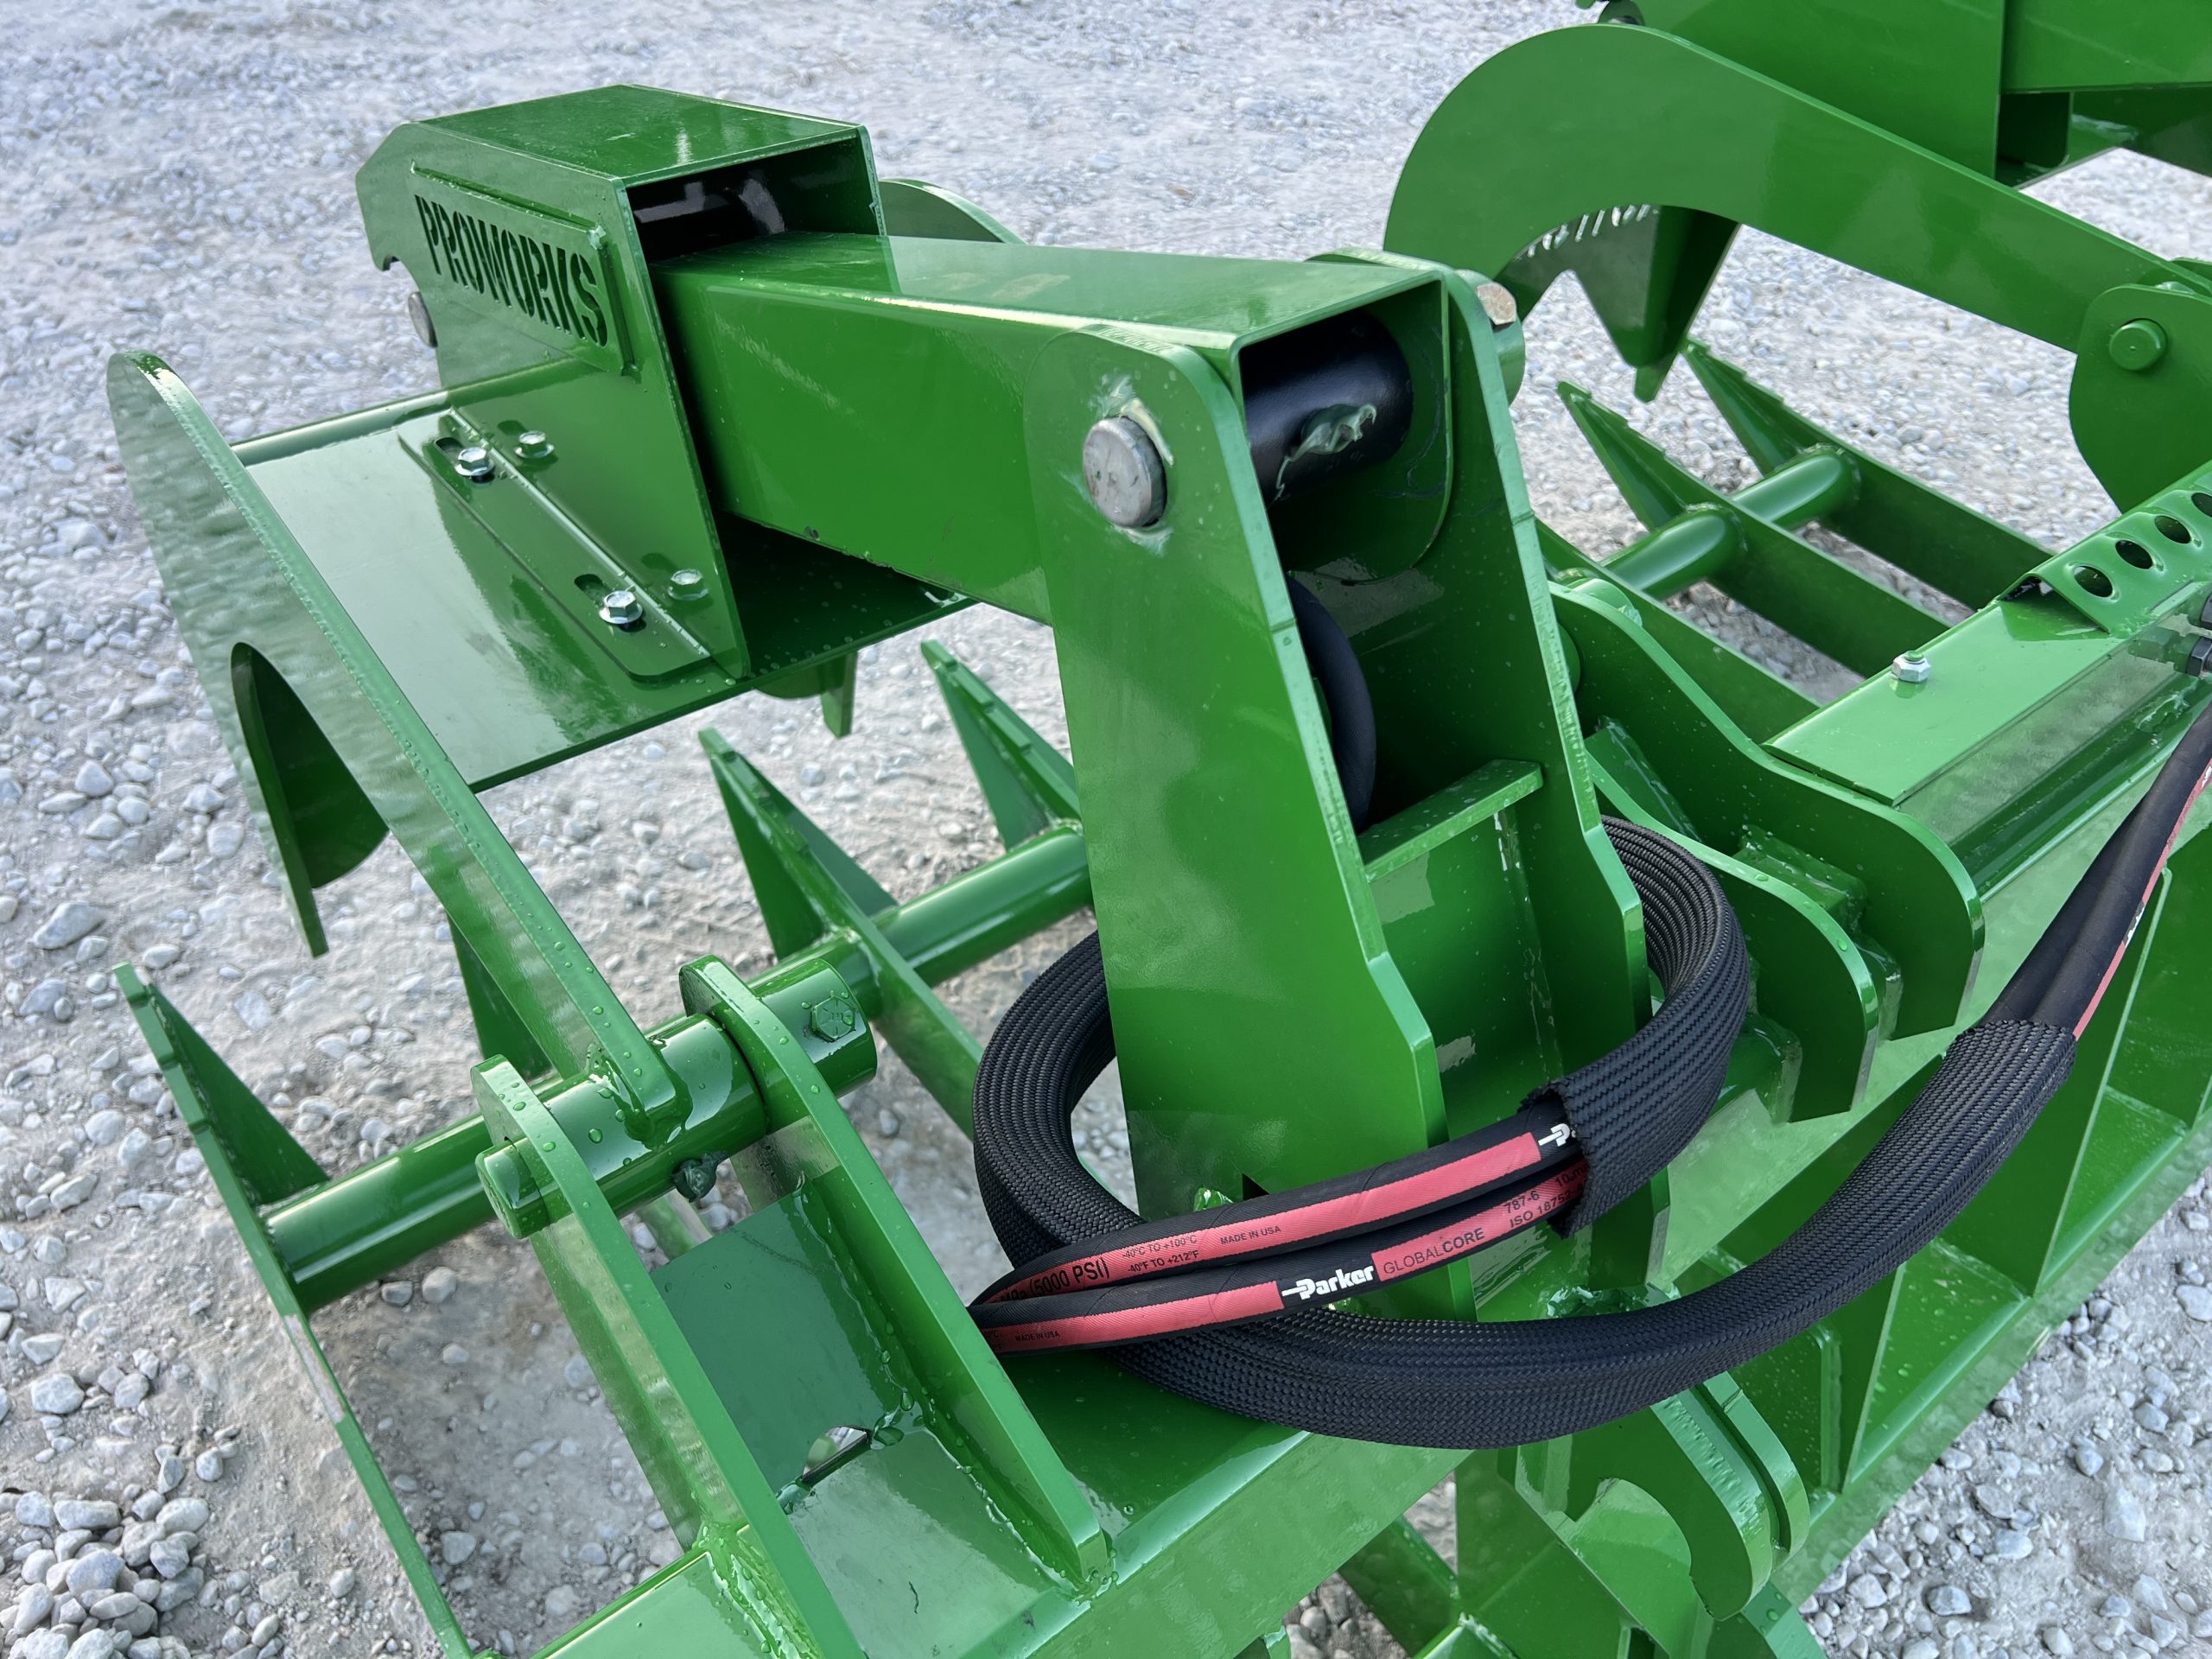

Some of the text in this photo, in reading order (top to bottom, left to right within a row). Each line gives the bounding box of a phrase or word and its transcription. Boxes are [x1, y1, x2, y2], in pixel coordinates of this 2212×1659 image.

[415, 194, 608, 347] PROWORKS
[1504, 1190, 1540, 1214] 787-6
[1510, 1211, 1534, 1228] ISO
[1220, 1225, 1281, 1245] MADE IN USA
[1147, 1243, 1160, 1253] TO
[1382, 1227, 1485, 1274] GLOBALCORE
[1072, 1256, 1110, 1284] PSI)
[1128, 1250, 1199, 1273] -40°F TO +212°F
[1295, 1265, 1375, 1300] Parker
[1015, 1330, 1061, 1342] MADE IN USA
